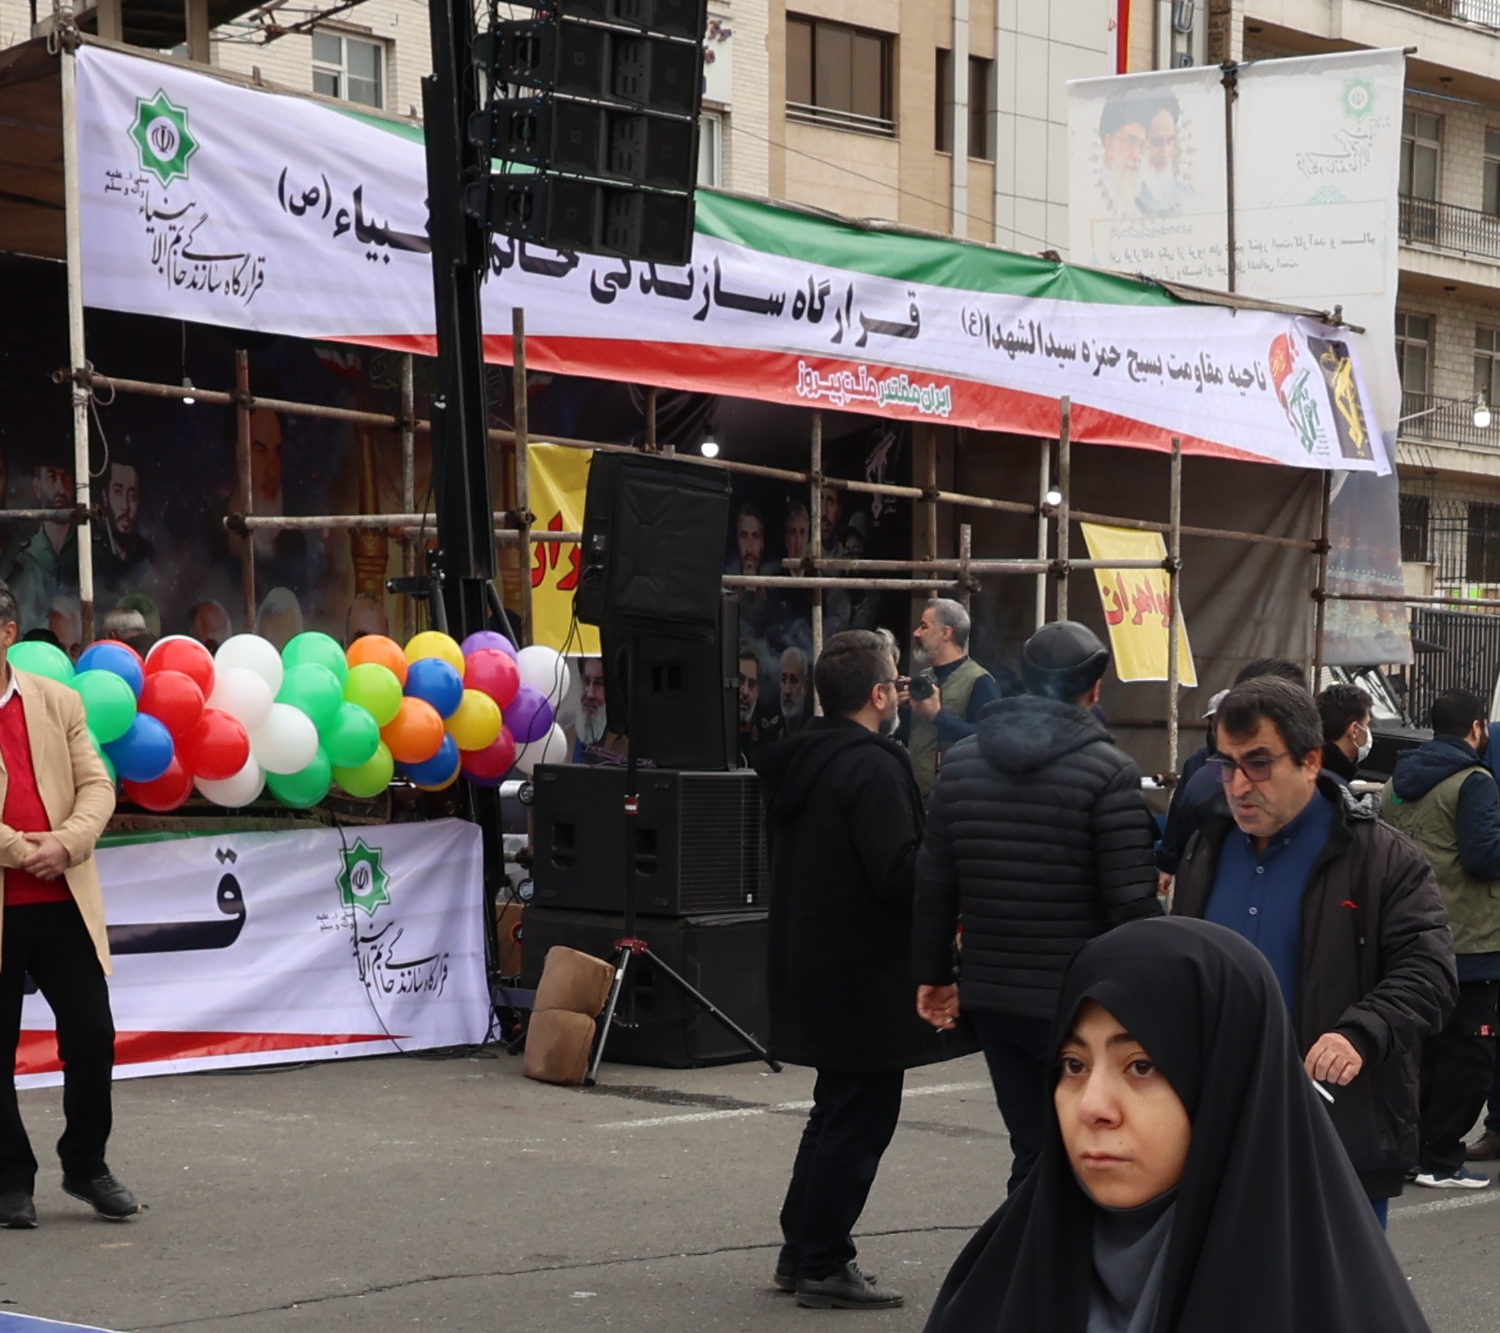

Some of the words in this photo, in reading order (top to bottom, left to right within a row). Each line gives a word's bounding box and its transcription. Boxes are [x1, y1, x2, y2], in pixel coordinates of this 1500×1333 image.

[791, 274, 922, 348] قرارگاه
[1081, 339, 1121, 376] حمزه
[1128, 347, 1163, 387] بسیج
[1169, 351, 1224, 393] مقاومت
[1229, 359, 1267, 396] ناحیه
[1102, 570, 1172, 628] واهران
